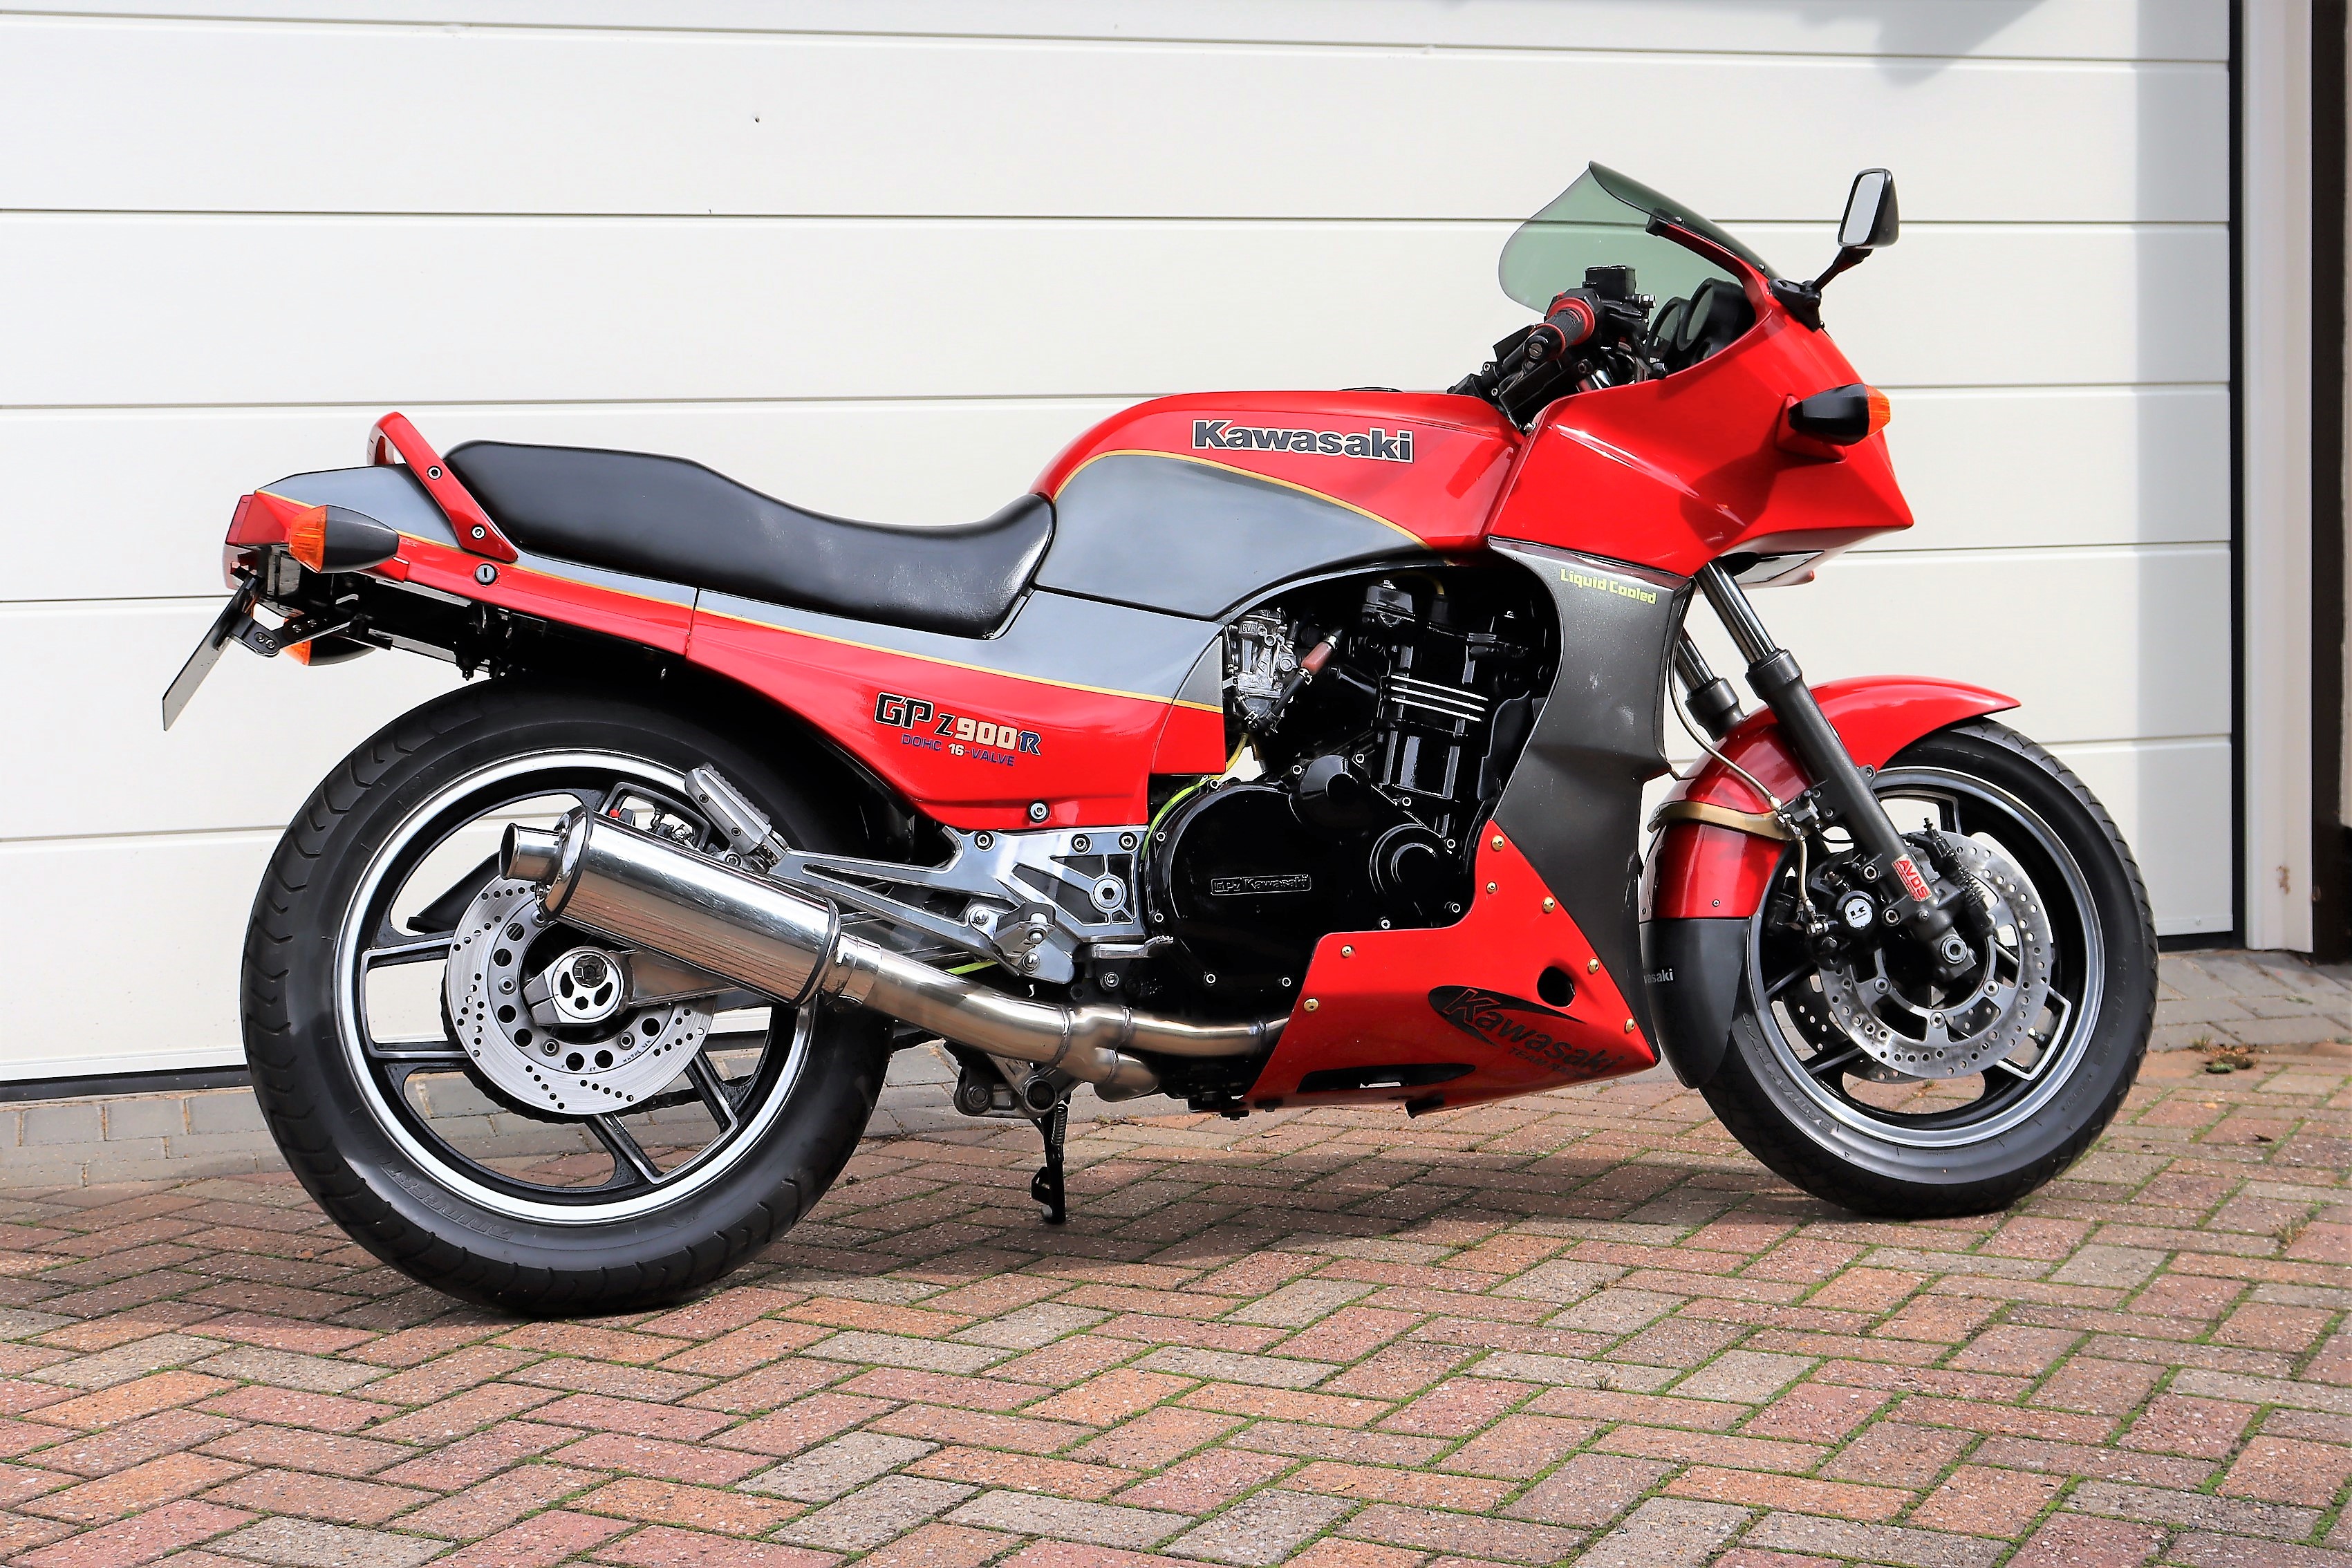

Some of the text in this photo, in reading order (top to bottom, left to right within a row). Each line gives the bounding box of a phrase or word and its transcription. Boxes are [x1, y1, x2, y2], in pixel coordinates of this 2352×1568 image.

[1192, 419, 1415, 464] Kawasaki
[1560, 568, 1658, 606] Liquid Cooled
[901, 734, 1016, 767] DOHC 16-VALVE
[1898, 859, 1930, 899] AVDS
[1442, 987, 1625, 1073] Kawasaki
